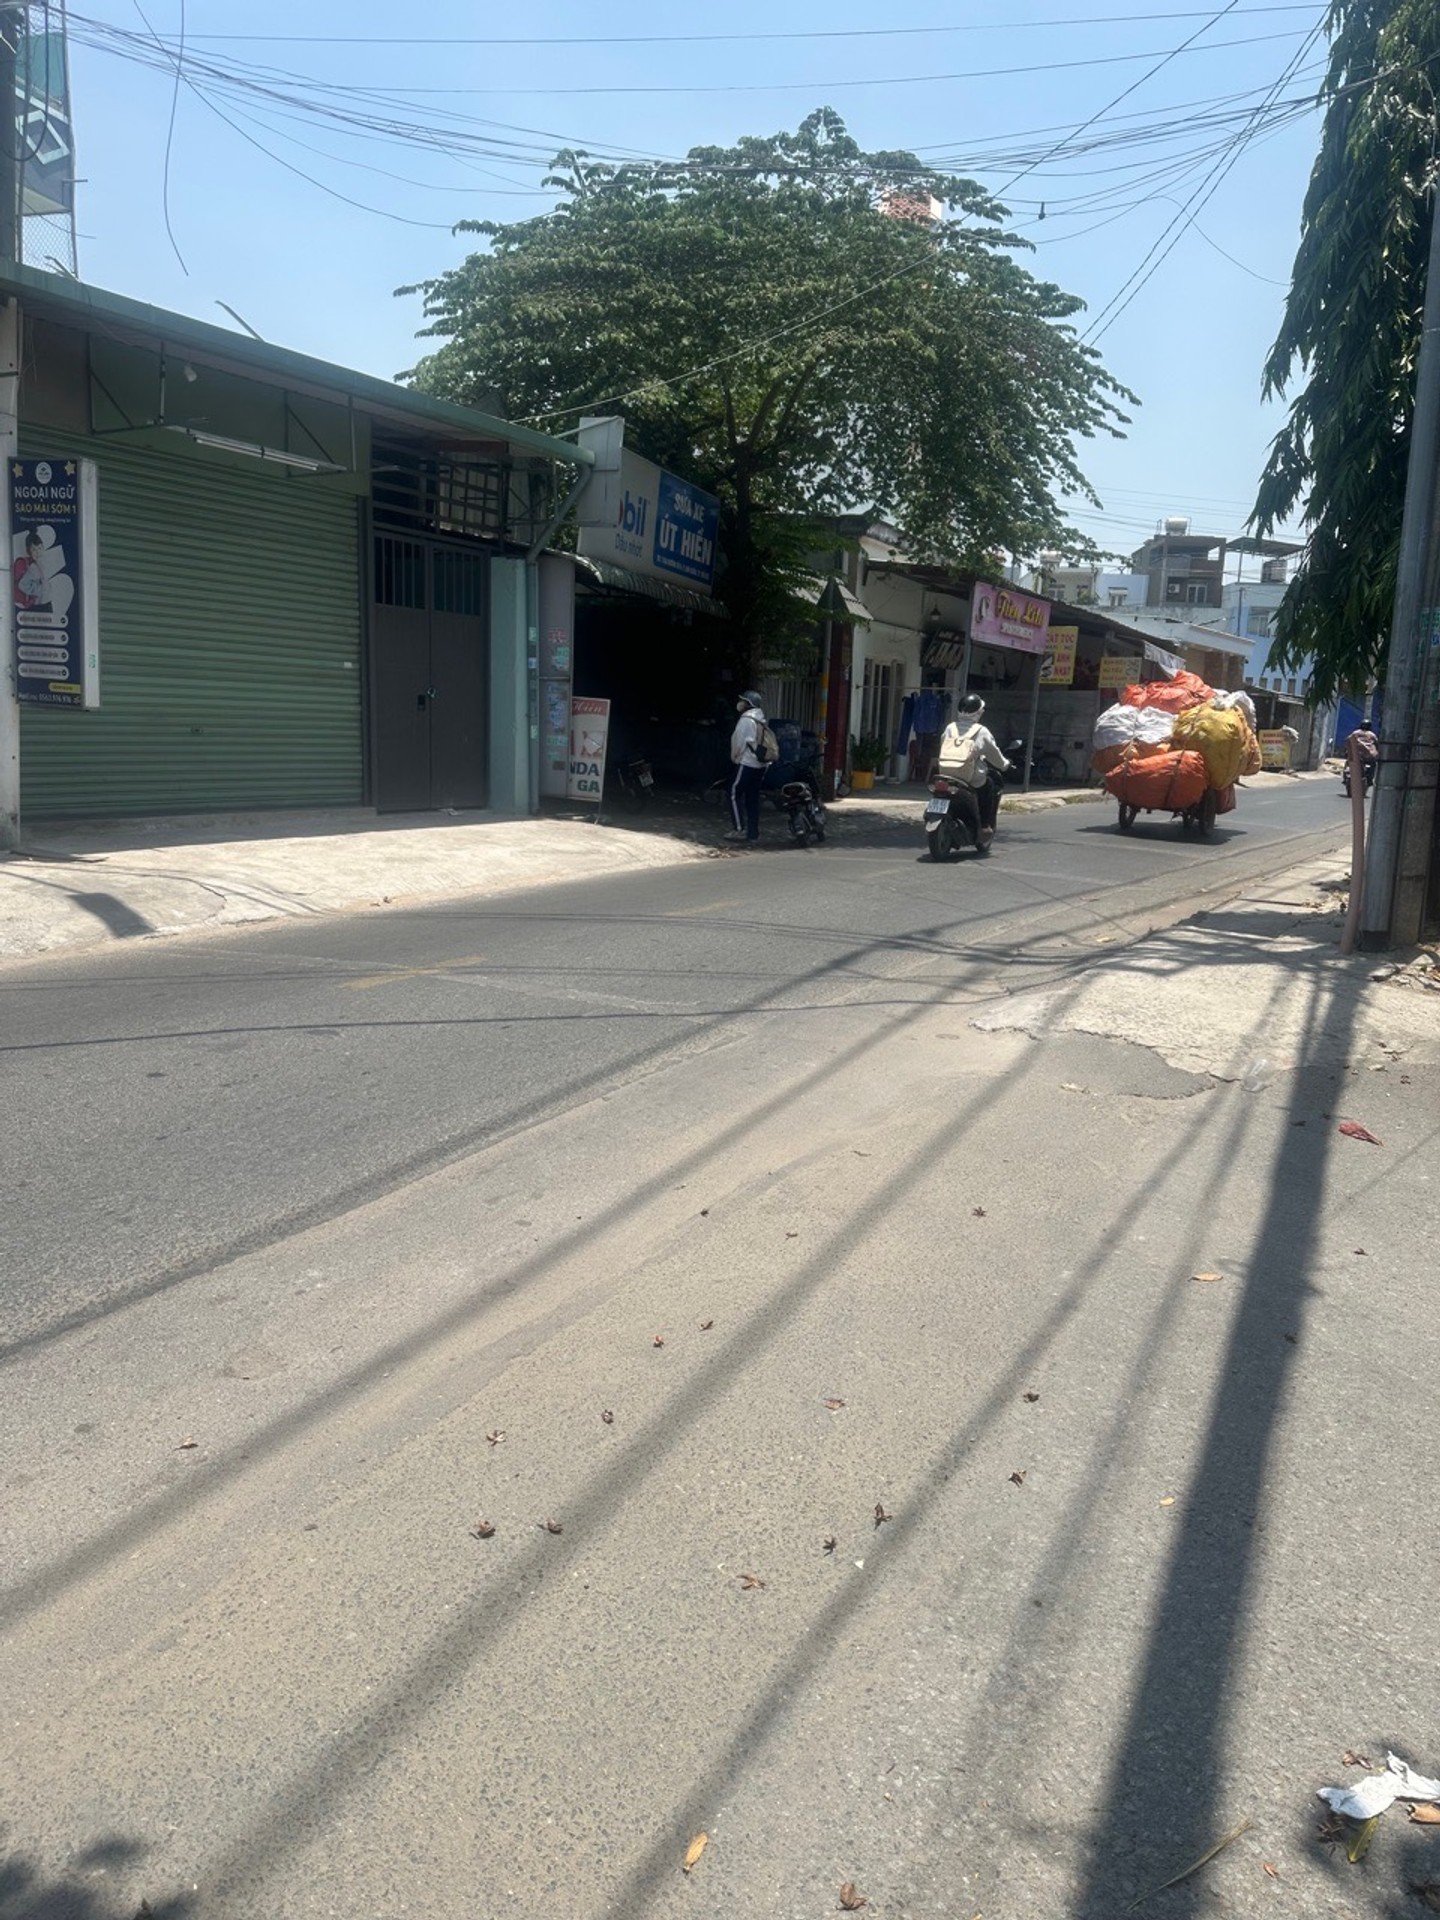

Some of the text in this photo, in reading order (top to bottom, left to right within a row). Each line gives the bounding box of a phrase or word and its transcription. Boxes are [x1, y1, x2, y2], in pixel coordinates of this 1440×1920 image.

[14, 484, 76, 502] NGOẠI NGỮ
[15, 503, 32, 513] SAO
[34, 503, 50, 513] MAI
[619, 490, 647, 537] bil
[660, 514, 678, 552] ÚT
[570, 761, 600, 776] NDA
[577, 779, 600, 793] GA
